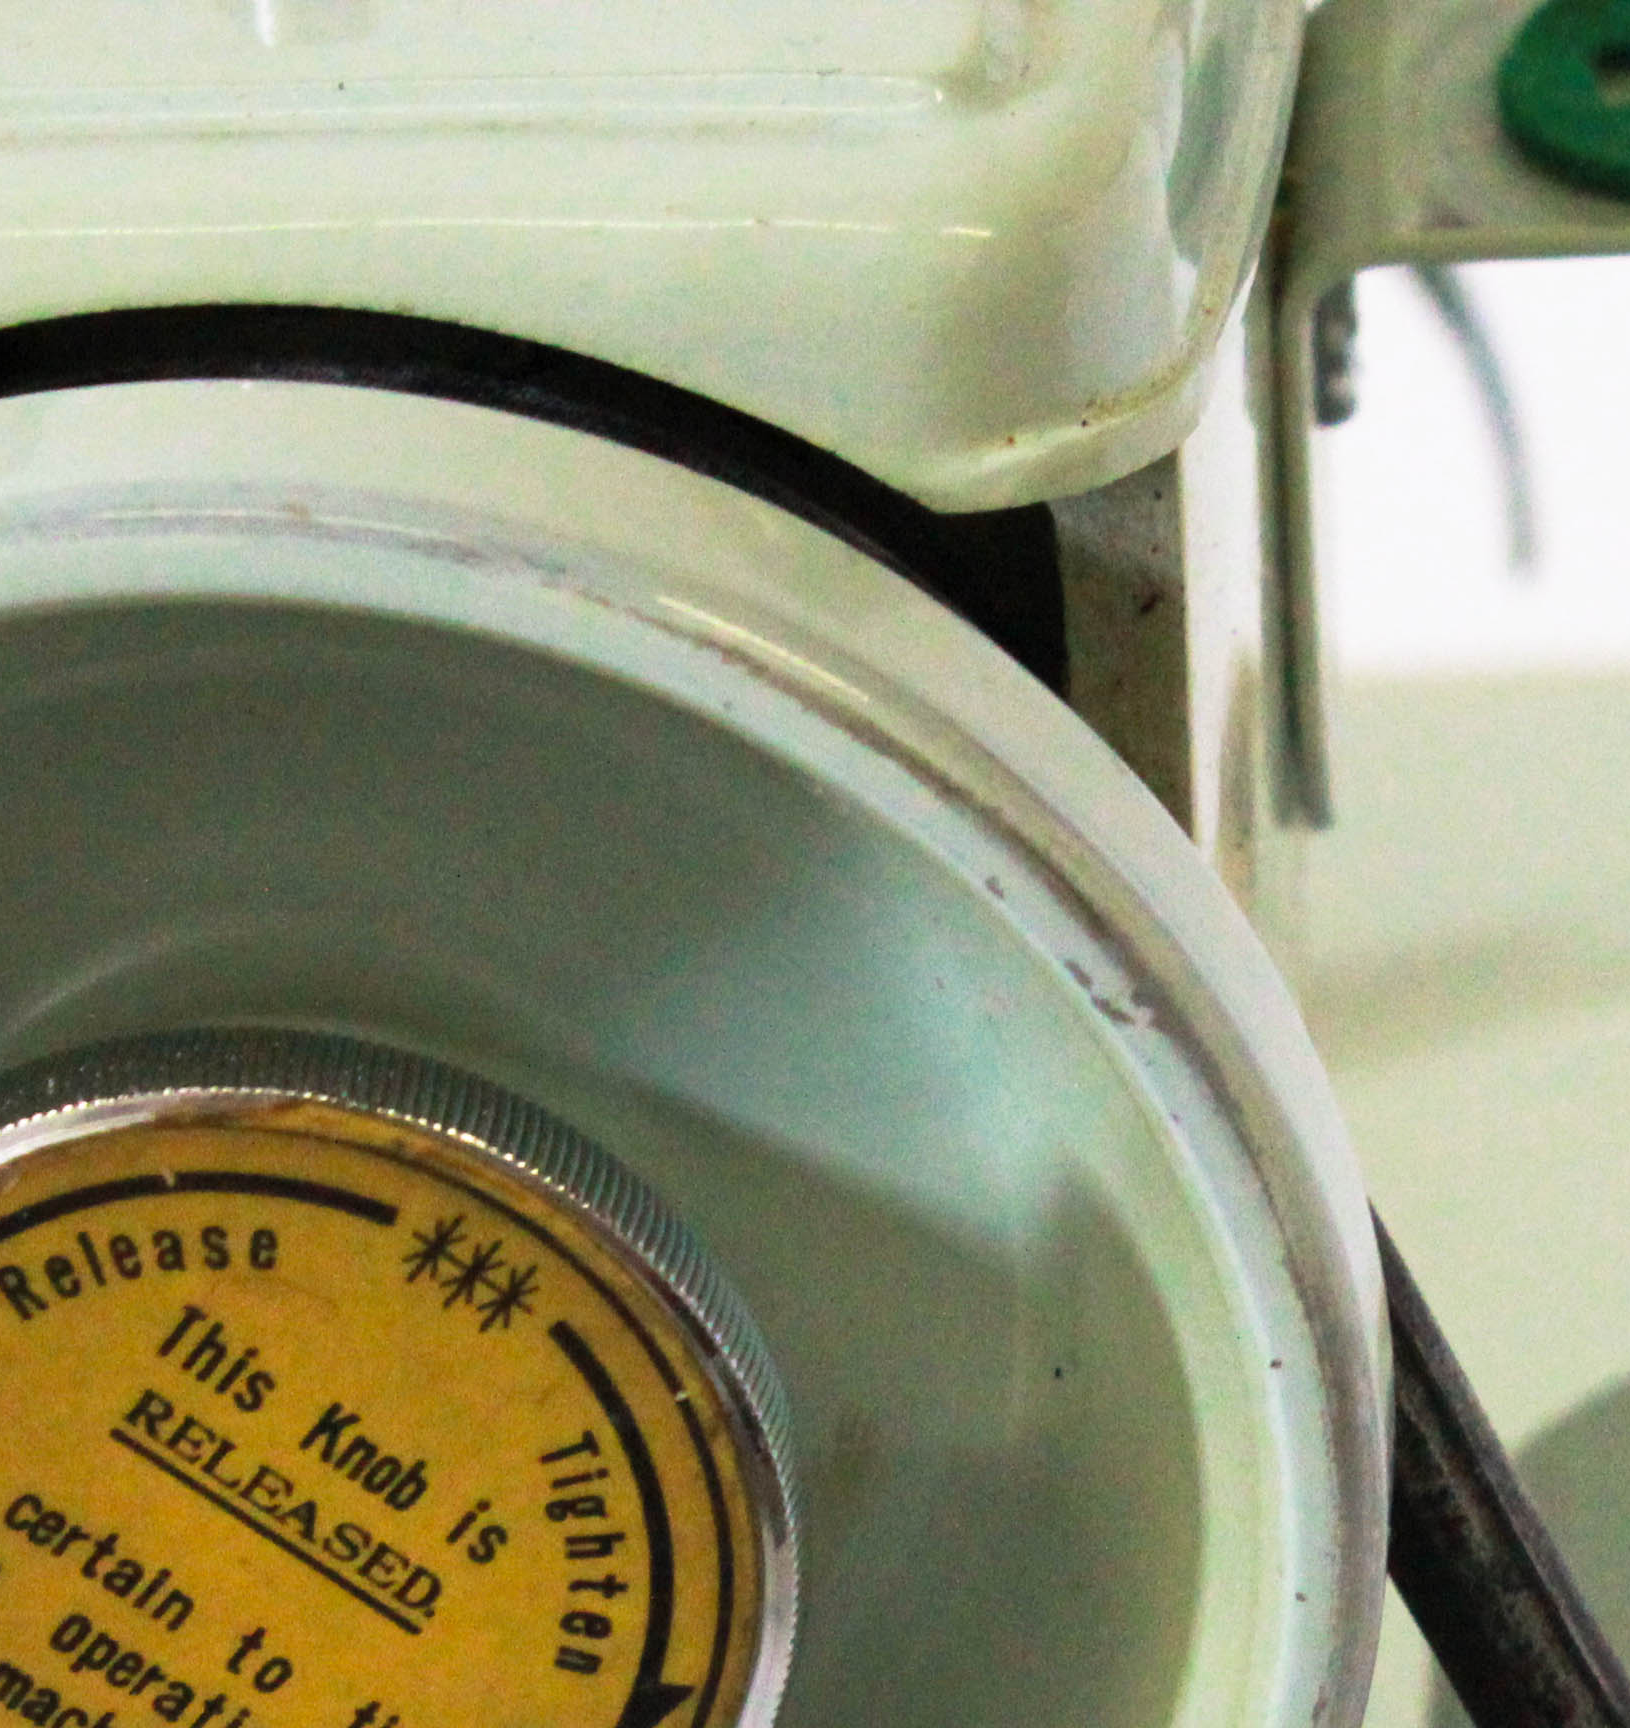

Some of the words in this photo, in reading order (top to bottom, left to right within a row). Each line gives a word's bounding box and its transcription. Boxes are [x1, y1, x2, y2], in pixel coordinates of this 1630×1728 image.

[157, 1304, 276, 1413] This
[299, 1401, 429, 1512] Knob
[446, 1499, 509, 1566] is
[540, 1430, 628, 1676] Tighten
[4, 1492, 195, 1632] certain
[226, 1626, 294, 1694] to
